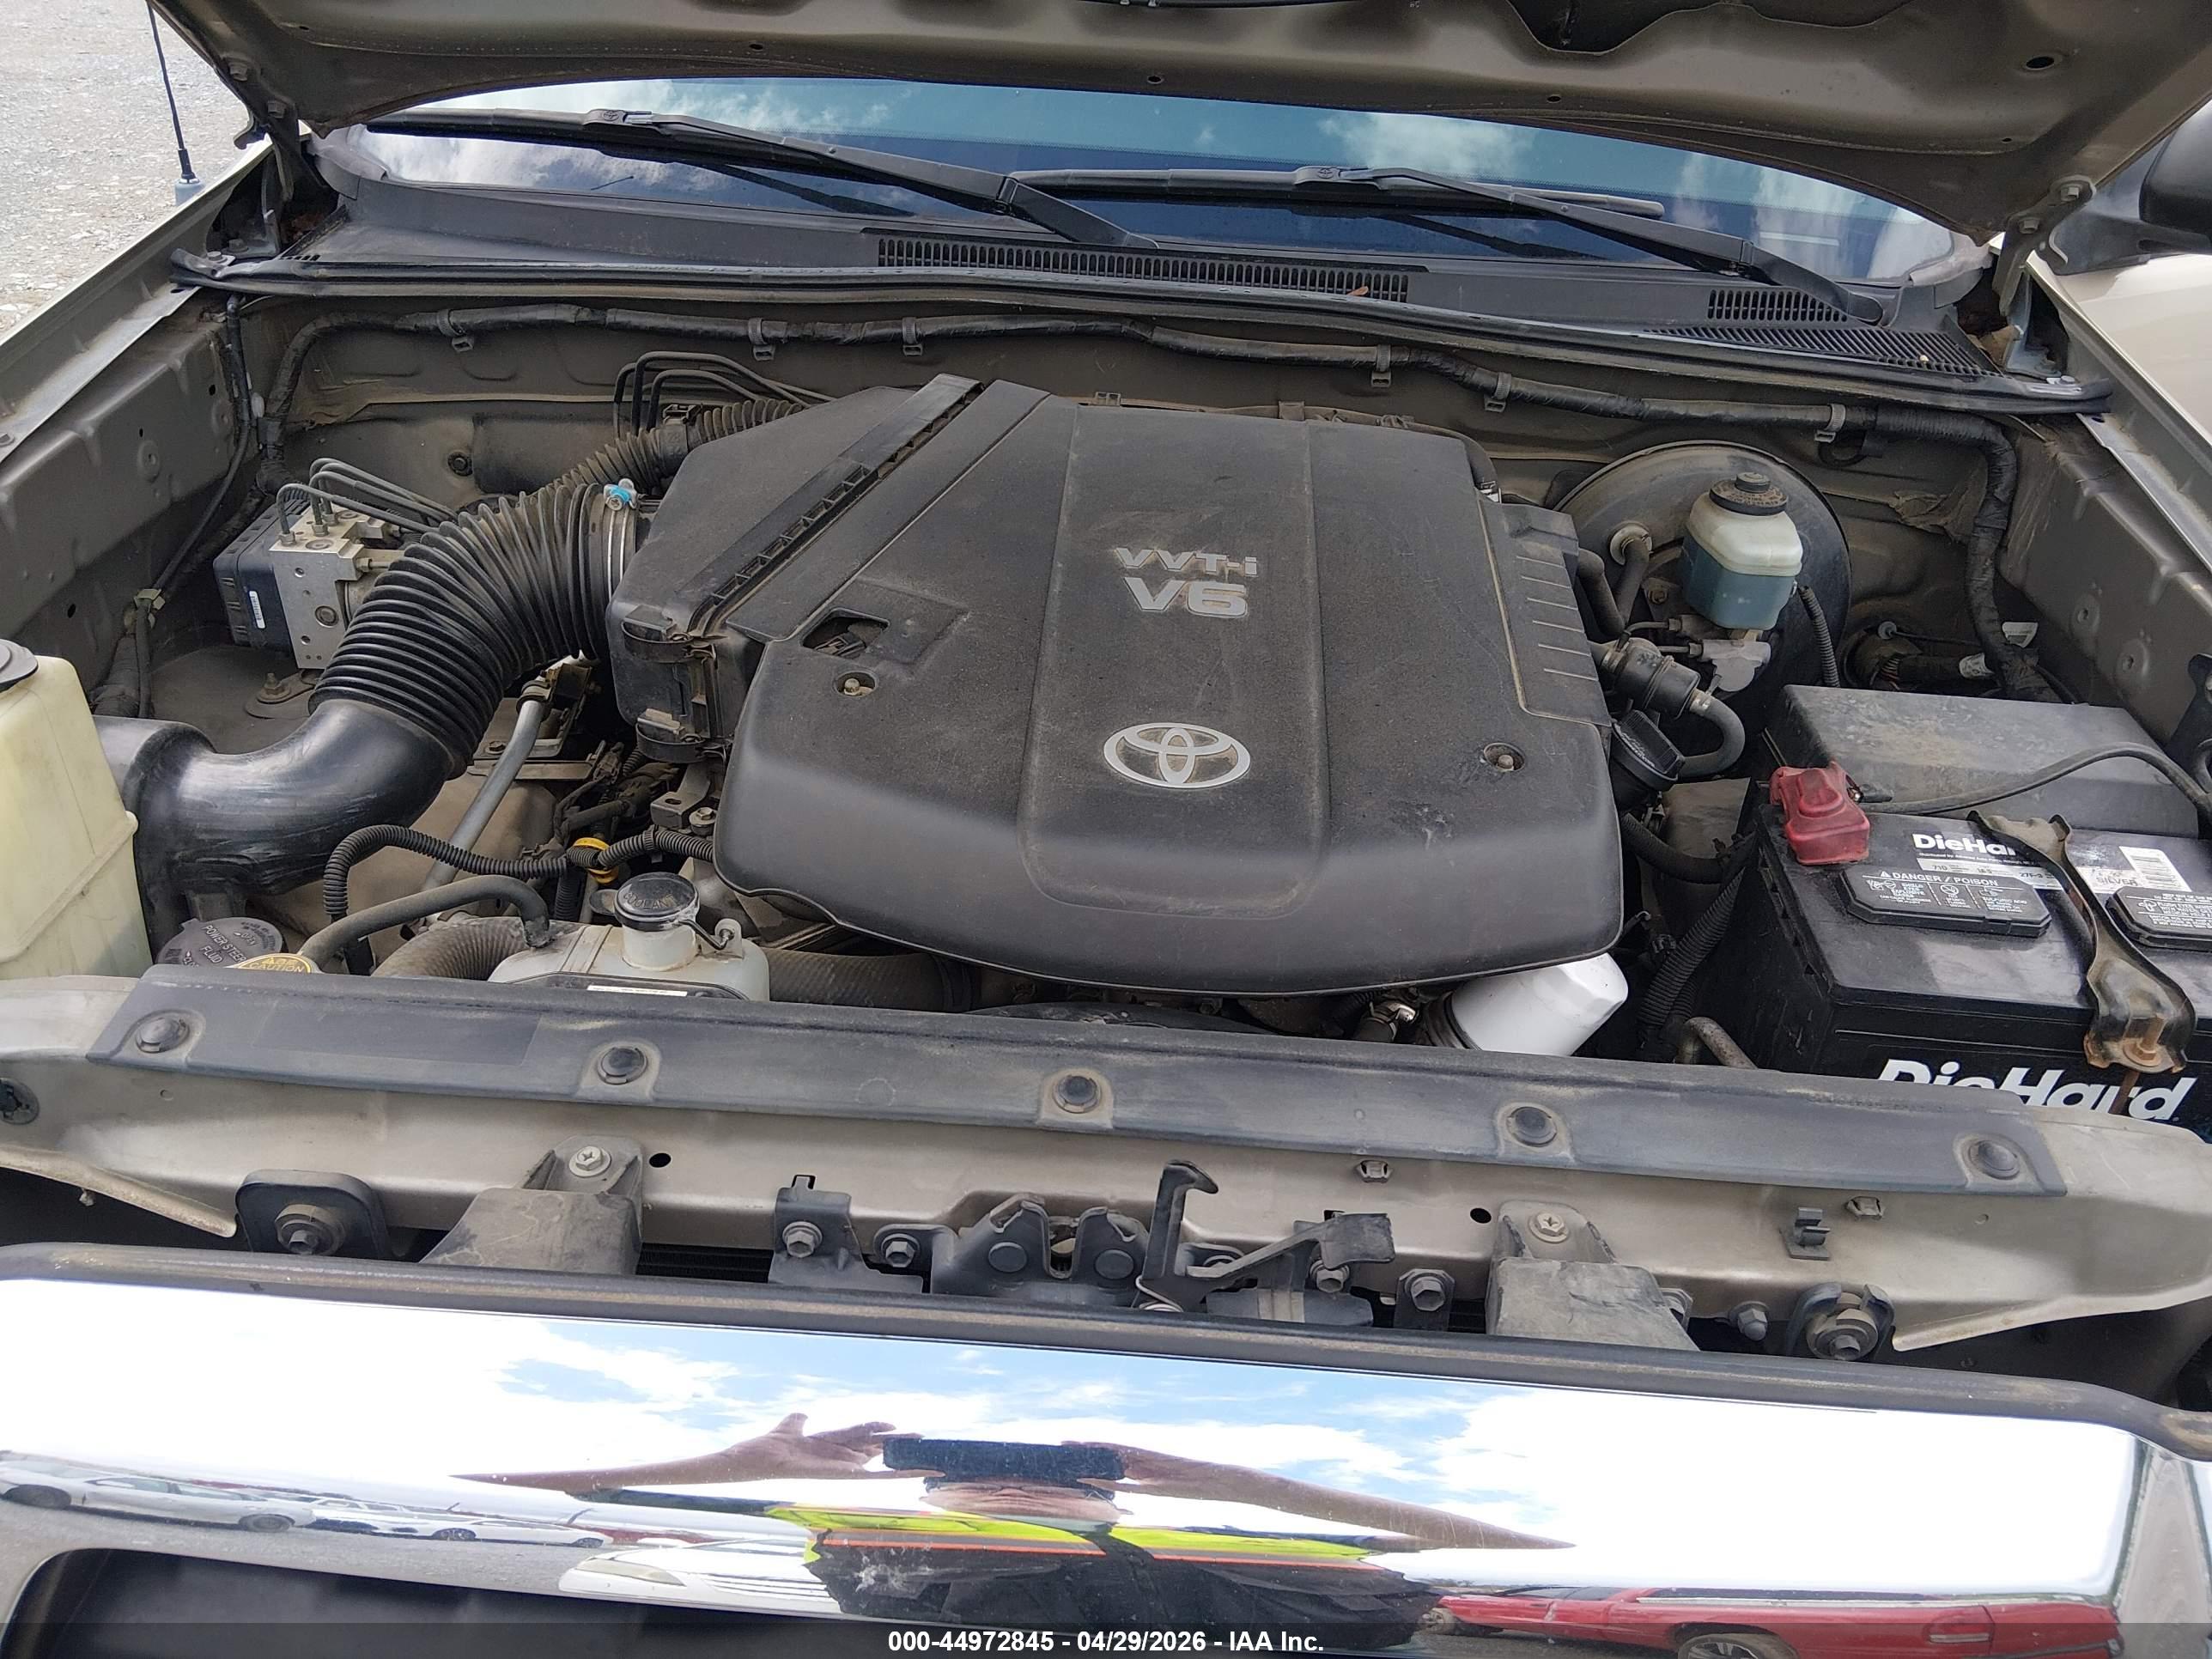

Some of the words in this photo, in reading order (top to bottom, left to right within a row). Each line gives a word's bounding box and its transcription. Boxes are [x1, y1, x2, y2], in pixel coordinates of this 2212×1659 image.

[1115, 547, 1258, 577] VVT-i
[1122, 576, 1249, 618] V6
[1911, 833, 2016, 856] DieHar
[1892, 872, 1942, 883] DANGER
[1953, 877, 1999, 886] POISON
[2095, 877, 2138, 887] SILVER
[623, 892, 678, 910] COOLANT
[201, 925, 229, 946] POWER
[222, 944, 247, 963] STEER
[199, 945, 223, 963] FLUID
[248, 962, 306, 973] CAUTION
